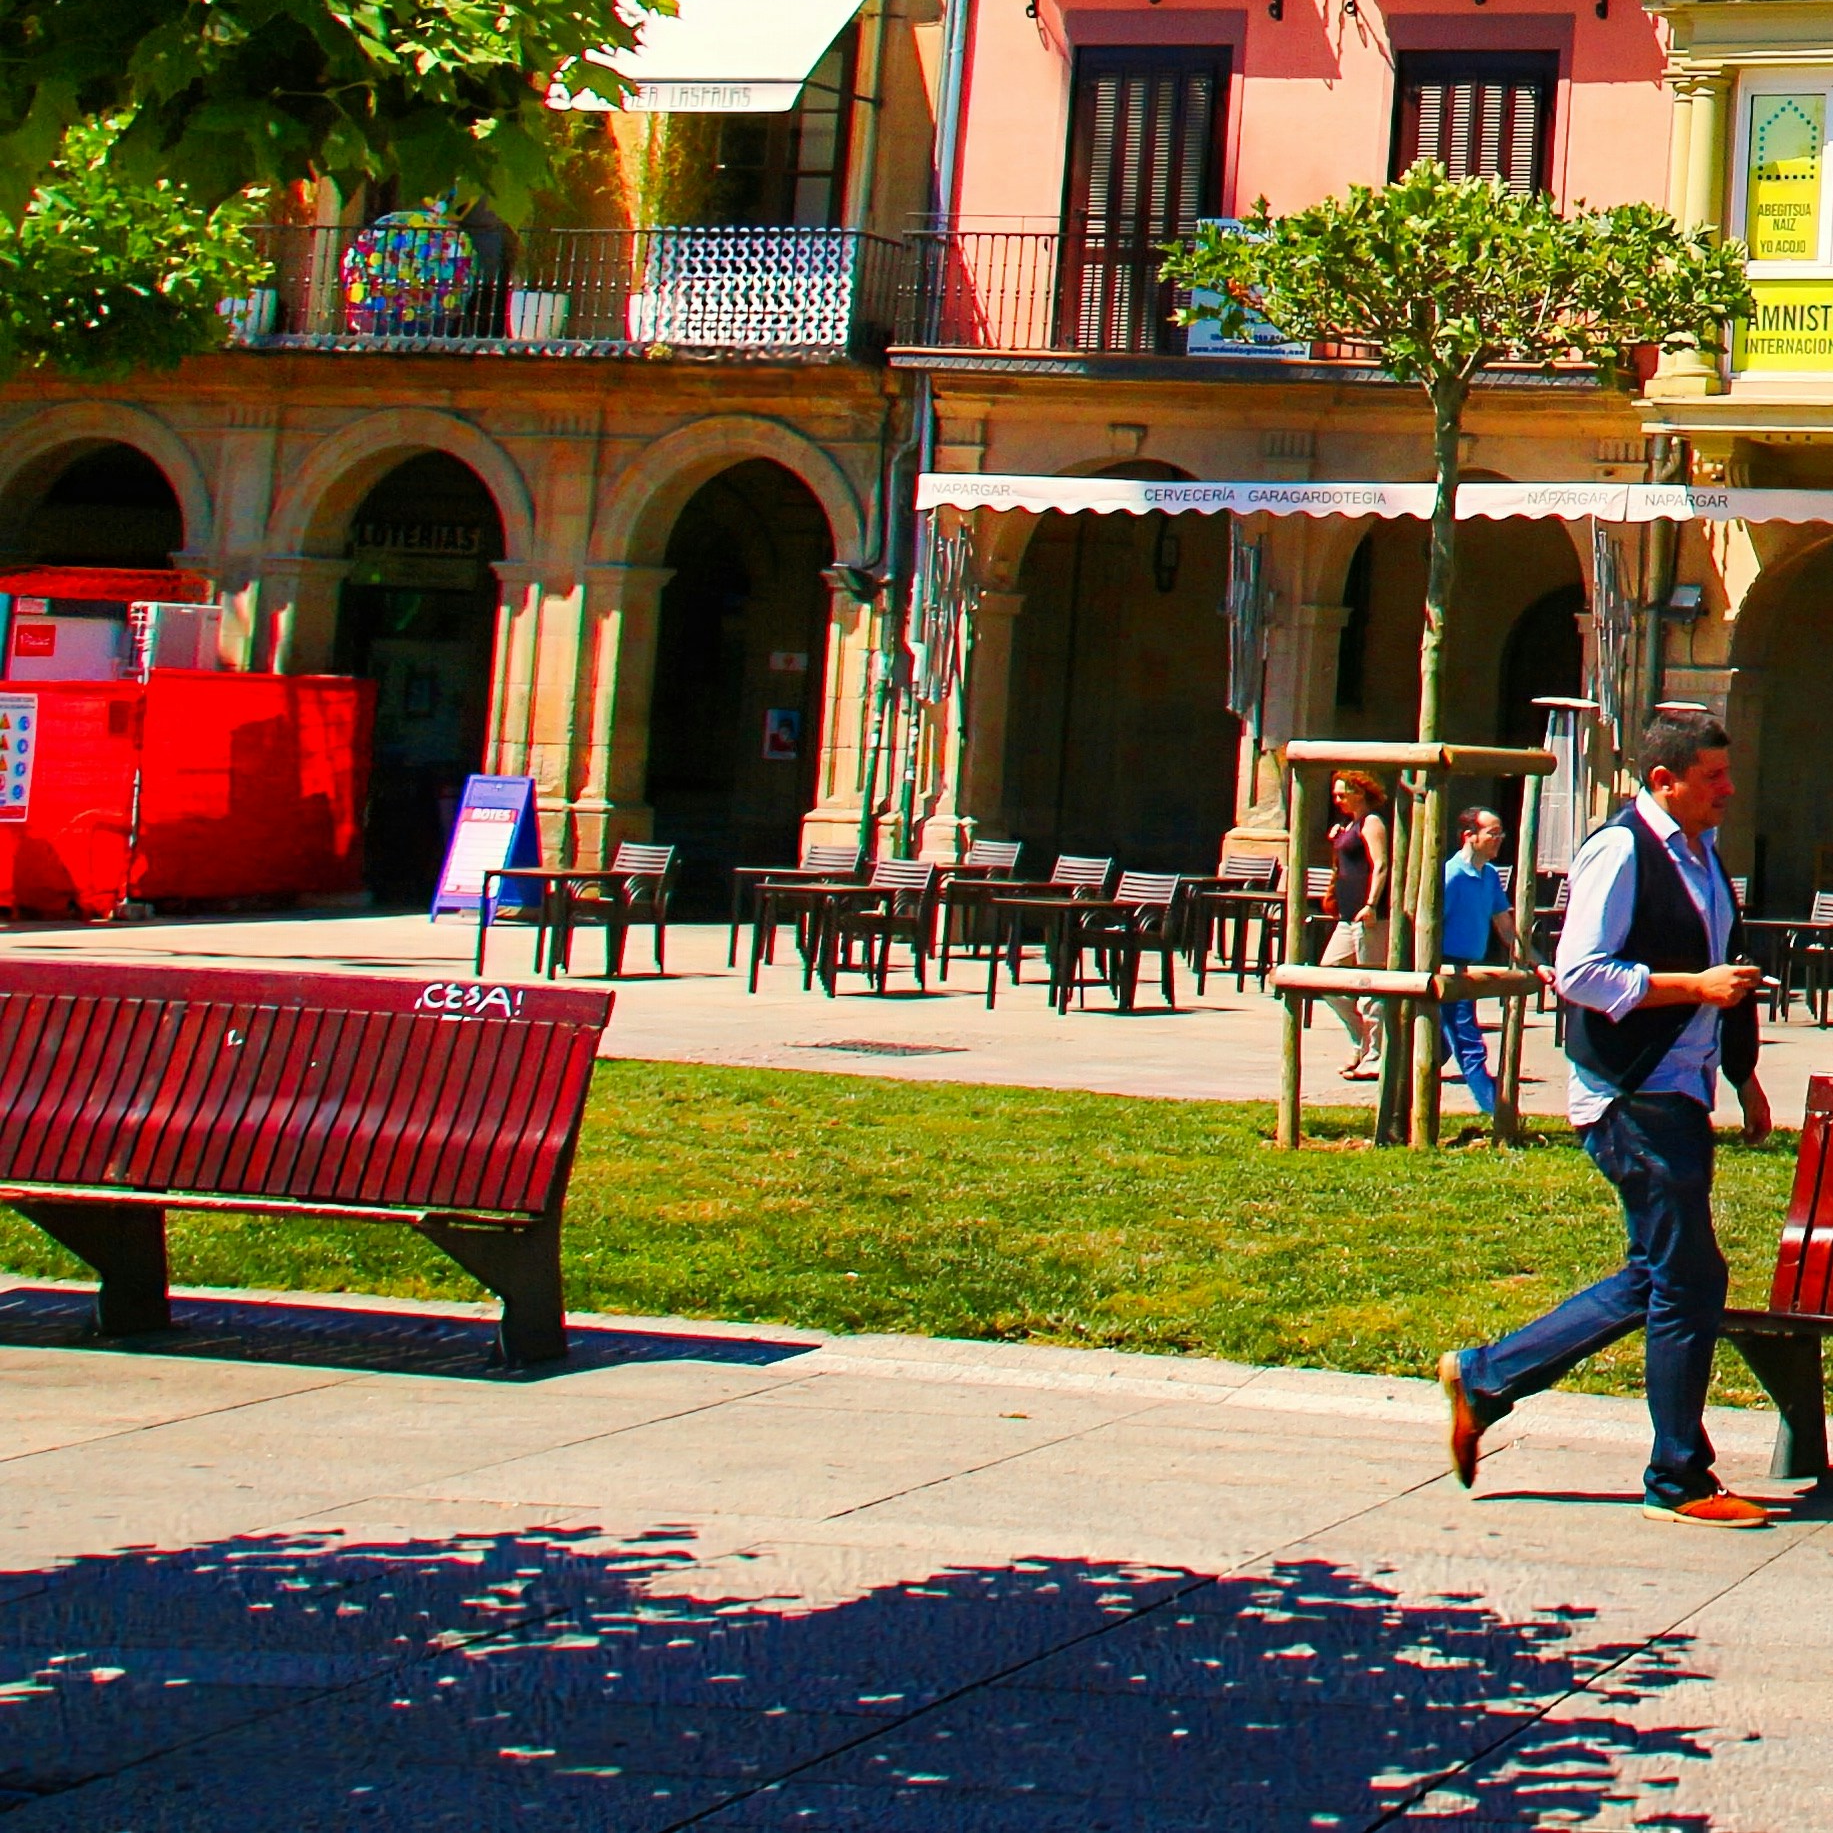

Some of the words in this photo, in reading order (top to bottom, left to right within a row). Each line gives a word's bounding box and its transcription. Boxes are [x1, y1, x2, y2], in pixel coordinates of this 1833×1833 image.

[1757, 203, 1812, 217] ABEGITSUA
[1772, 218, 1797, 231] NAIZ
[1760, 240, 1773, 253] YO
[1775, 240, 1806, 253] ACOJO
[932, 482, 1011, 497] NAPARGAR
[1144, 486, 1236, 502] CERVECERÍA
[1248, 489, 1387, 505] GARAGARDOTEGIA
[1527, 491, 1609, 505] NAPARGAR
[1645, 493, 1729, 509] NAPARGAR
[472, 808, 511, 822] BOTES
